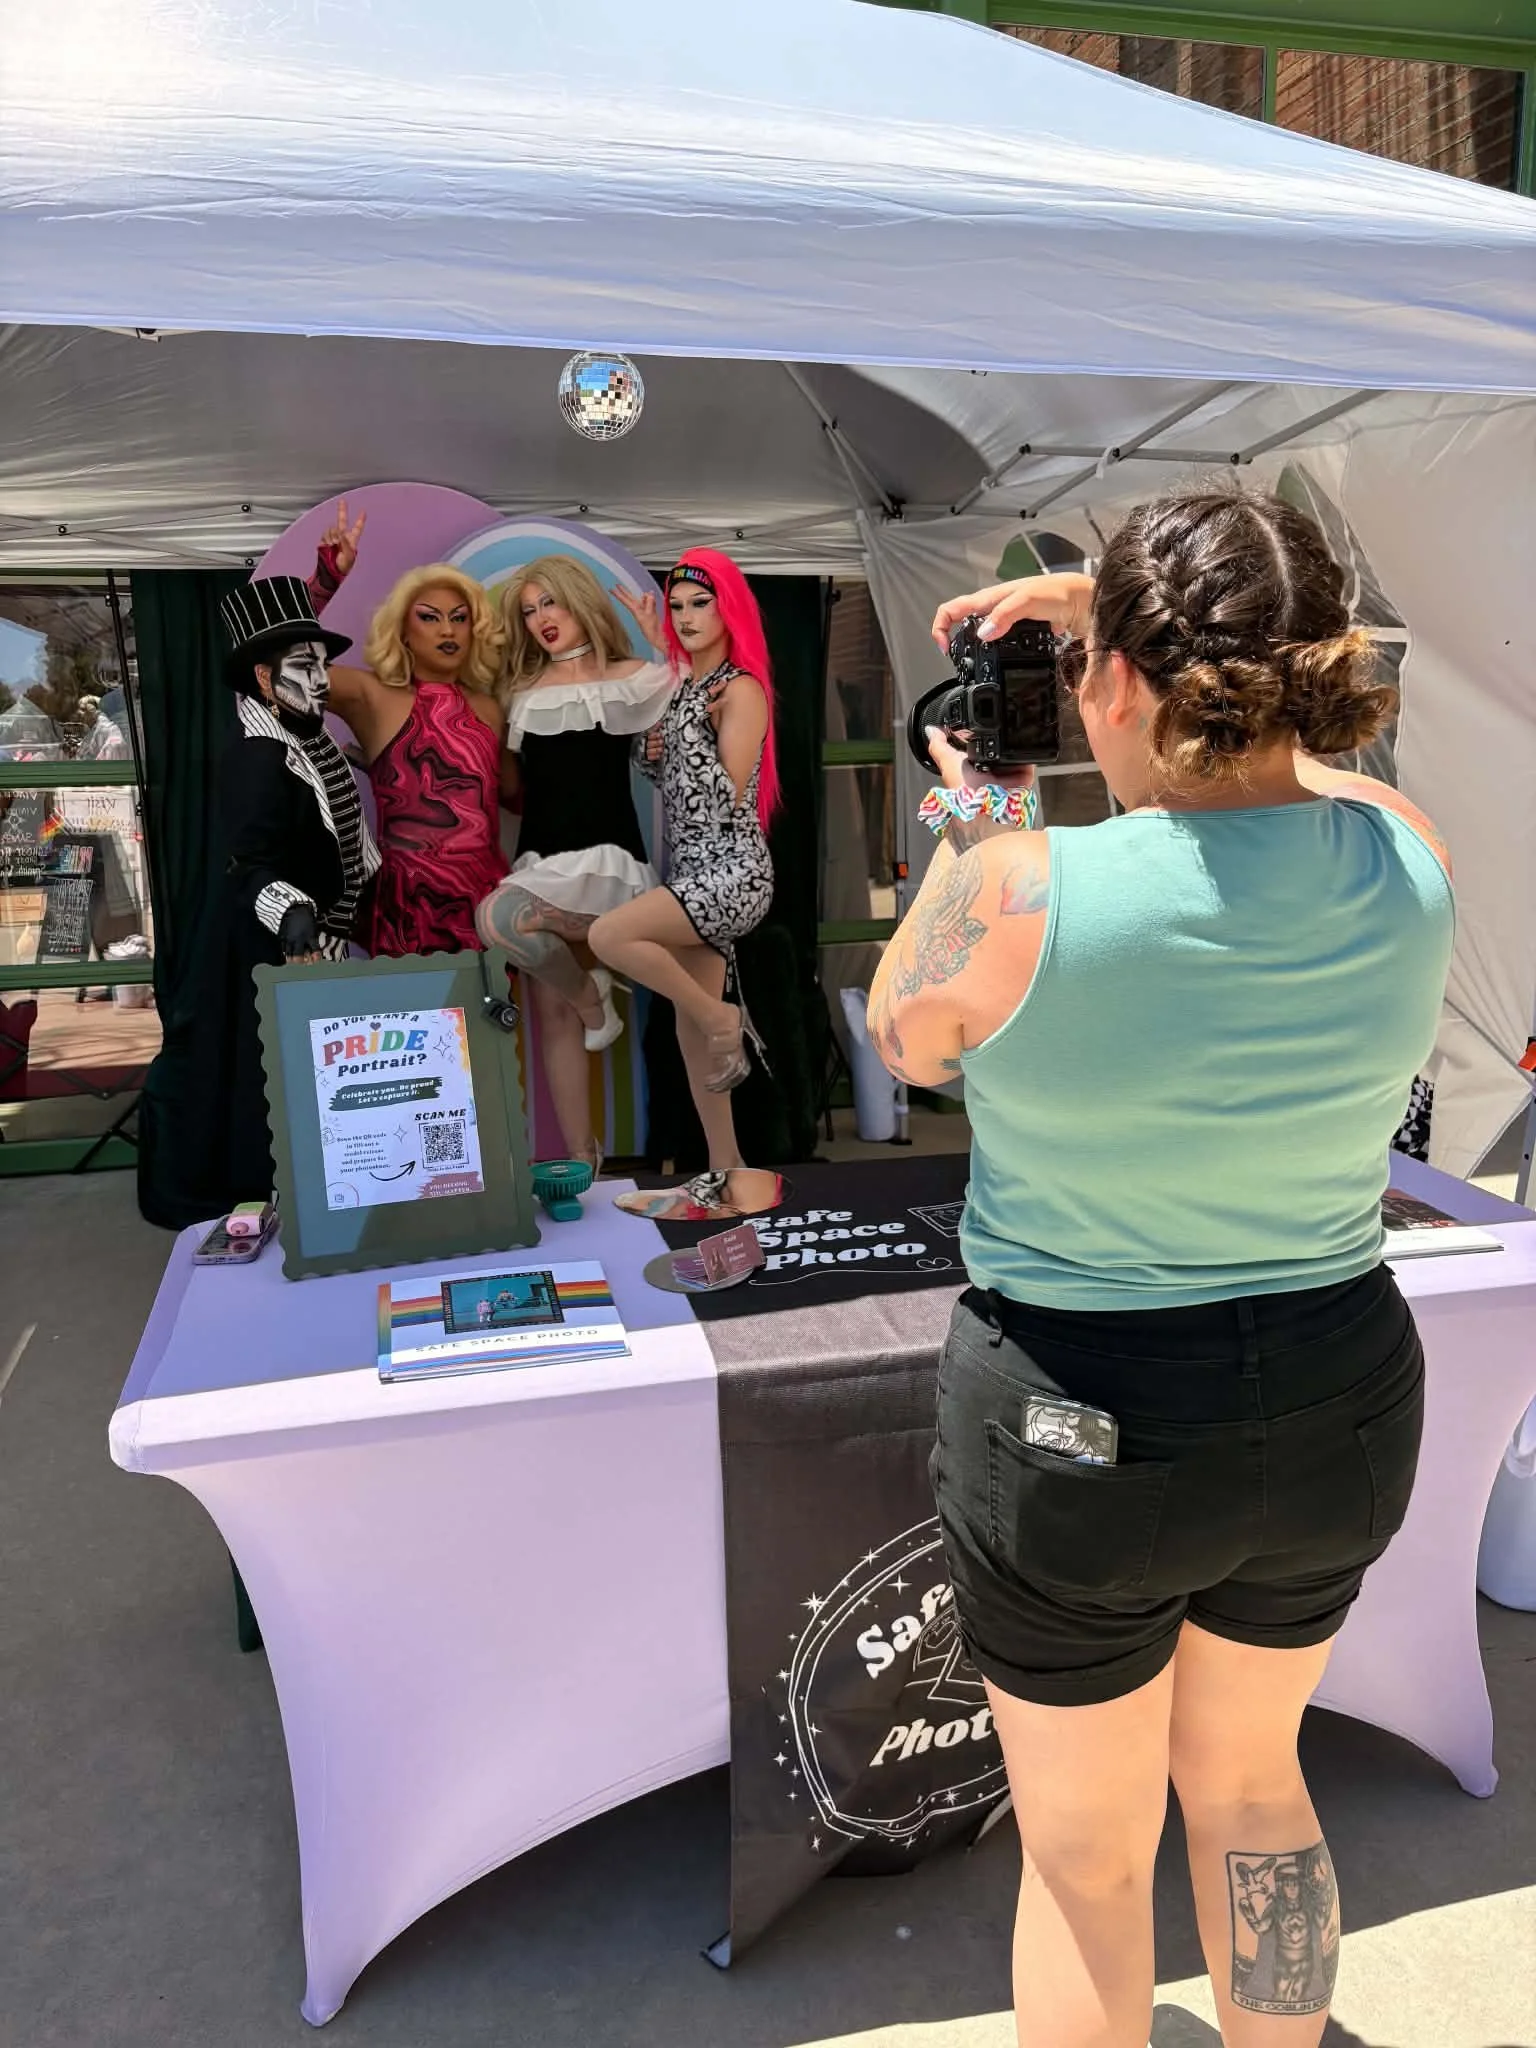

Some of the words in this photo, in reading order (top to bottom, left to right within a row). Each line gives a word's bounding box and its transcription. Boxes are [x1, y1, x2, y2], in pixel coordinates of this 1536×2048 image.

[323, 1022, 339, 1035] DO
[342, 1015, 367, 1026] YOU
[410, 1014, 419, 1022] A
[322, 1027, 429, 1067] PRIDE
[338, 1053, 427, 1078] Portrait?
[341, 1089, 379, 1100] Celebrate
[410, 1079, 434, 1090] proud
[379, 1091, 410, 1101] capture
[415, 1111, 446, 1121] SCAN
[448, 1108, 467, 1117] ME
[743, 1209, 853, 1231] Safe
[755, 1222, 906, 1248] Space
[764, 1243, 927, 1271] Photo
[415, 1342, 463, 1353] SAFE
[470, 1334, 529, 1346] SPACE
[536, 1329, 599, 1340] PHOTO
[869, 1706, 996, 1768] Phot
